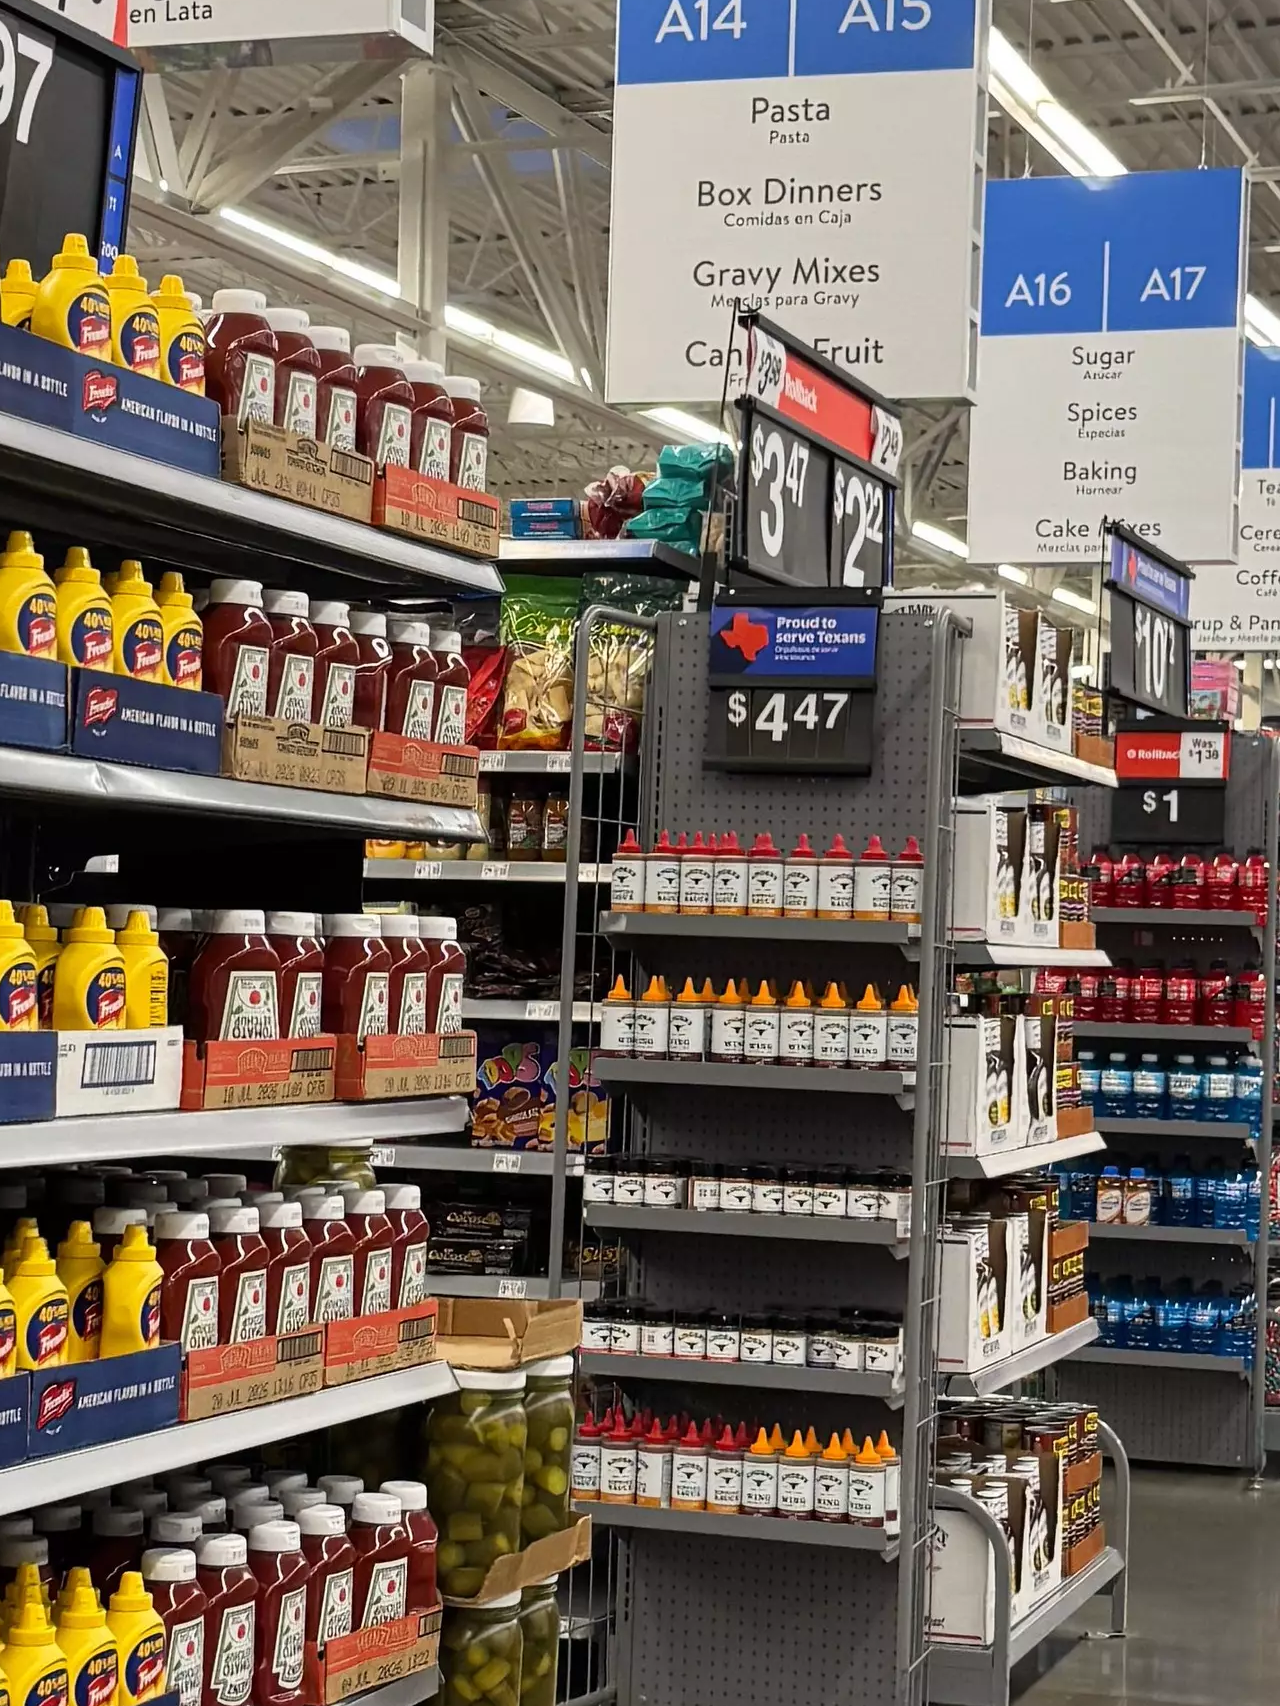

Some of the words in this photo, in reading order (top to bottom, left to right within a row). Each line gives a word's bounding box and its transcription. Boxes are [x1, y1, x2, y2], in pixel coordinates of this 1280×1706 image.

[130, 6, 156, 24] en
[166, 0, 213, 22] Lata
[751, 97, 830, 124] Pasta
[769, 131, 809, 144] Pasta
[698, 181, 752, 207] Box
[765, 177, 882, 205] Dinners
[723, 212, 790, 227] Comidas
[796, 214, 814, 226] en
[819, 210, 851, 227] Caja
[693, 260, 782, 293] Gravy
[793, 257, 879, 284] Mixes
[1140, 266, 1207, 303] A17
[775, 296, 808, 310] para
[814, 292, 859, 309] Gravy
[1004, 273, 1072, 308] A16
[814, 338, 884, 365] Fruit
[1072, 346, 1135, 371] Sugar
[41, 374, 68, 398] BOTTLE
[784, 371, 818, 414] Rollback
[1067, 402, 1138, 428] Spices
[1078, 429, 1126, 441] Especias
[1063, 461, 1137, 484] Baking
[1076, 485, 1123, 495] Hornear
[1035, 519, 1090, 538] Cake
[1036, 541, 1079, 553] Mezclas
[777, 616, 819, 630] Proud
[823, 617, 836, 630] to
[1230, 616, 1243, 631] &
[776, 632, 813, 644] serve
[817, 630, 866, 644] Texans
[0, 683, 28, 700] FLAVOR
[1138, 749, 1180, 760] Rollbac
